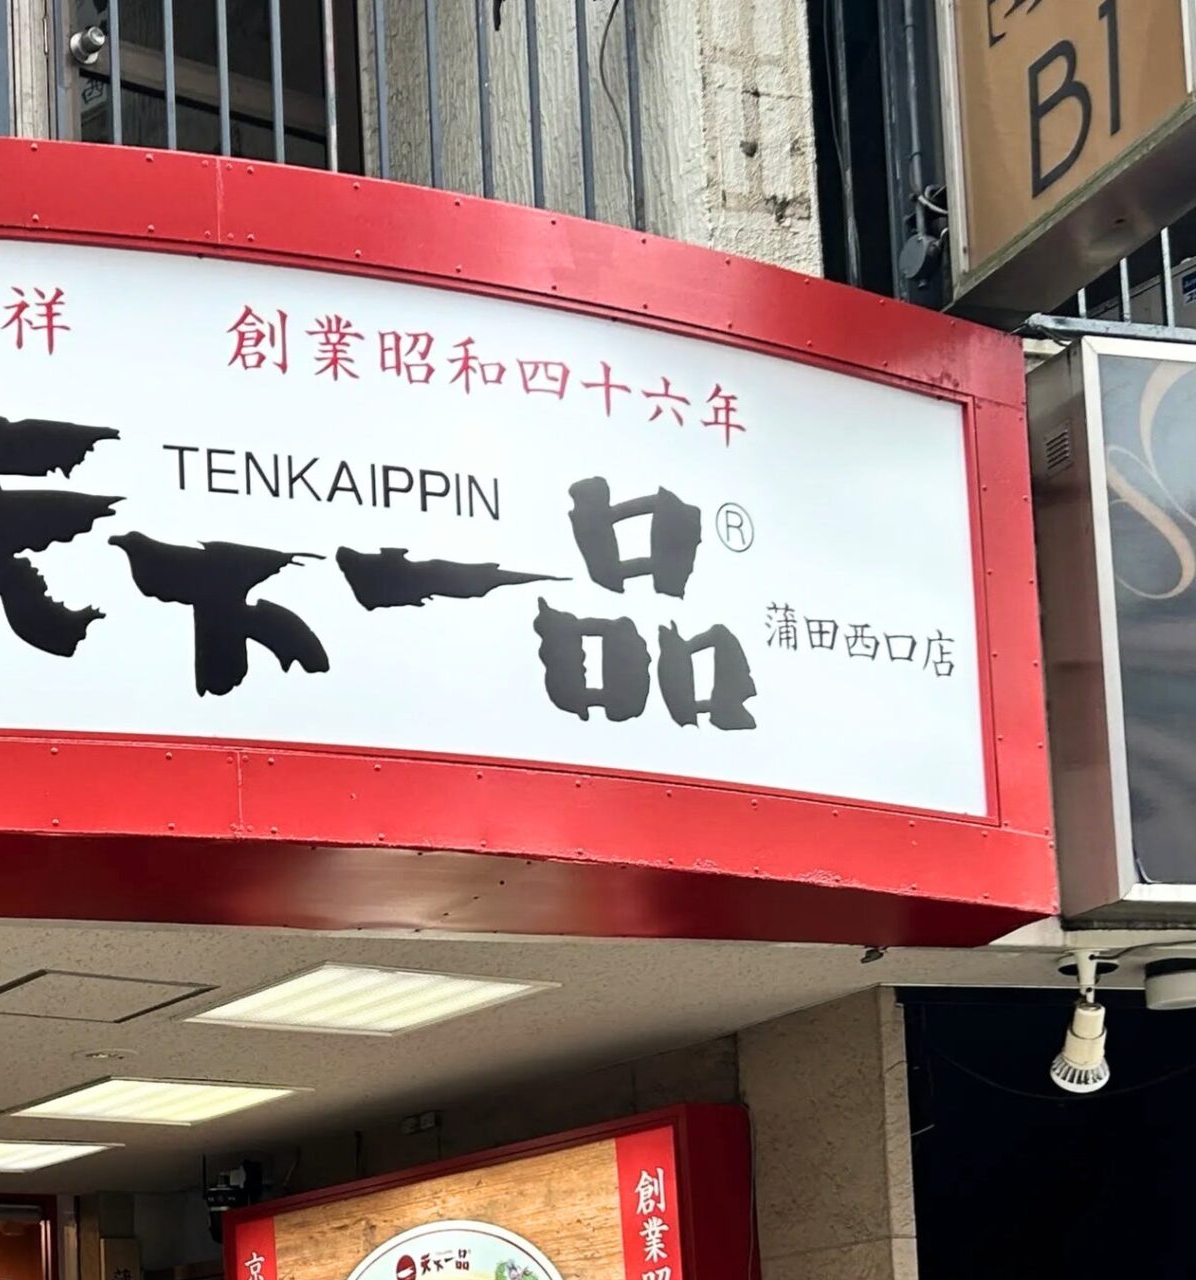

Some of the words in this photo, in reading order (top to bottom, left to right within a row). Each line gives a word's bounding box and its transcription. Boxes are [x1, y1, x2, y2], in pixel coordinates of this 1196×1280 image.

[1028, 0, 1121, 199] B1
[228, 305, 746, 447] 創業昭和四十六年
[162, 445, 499, 521] TENKAIPPIN
[765, 601, 956, 677] 蒲田西口店
